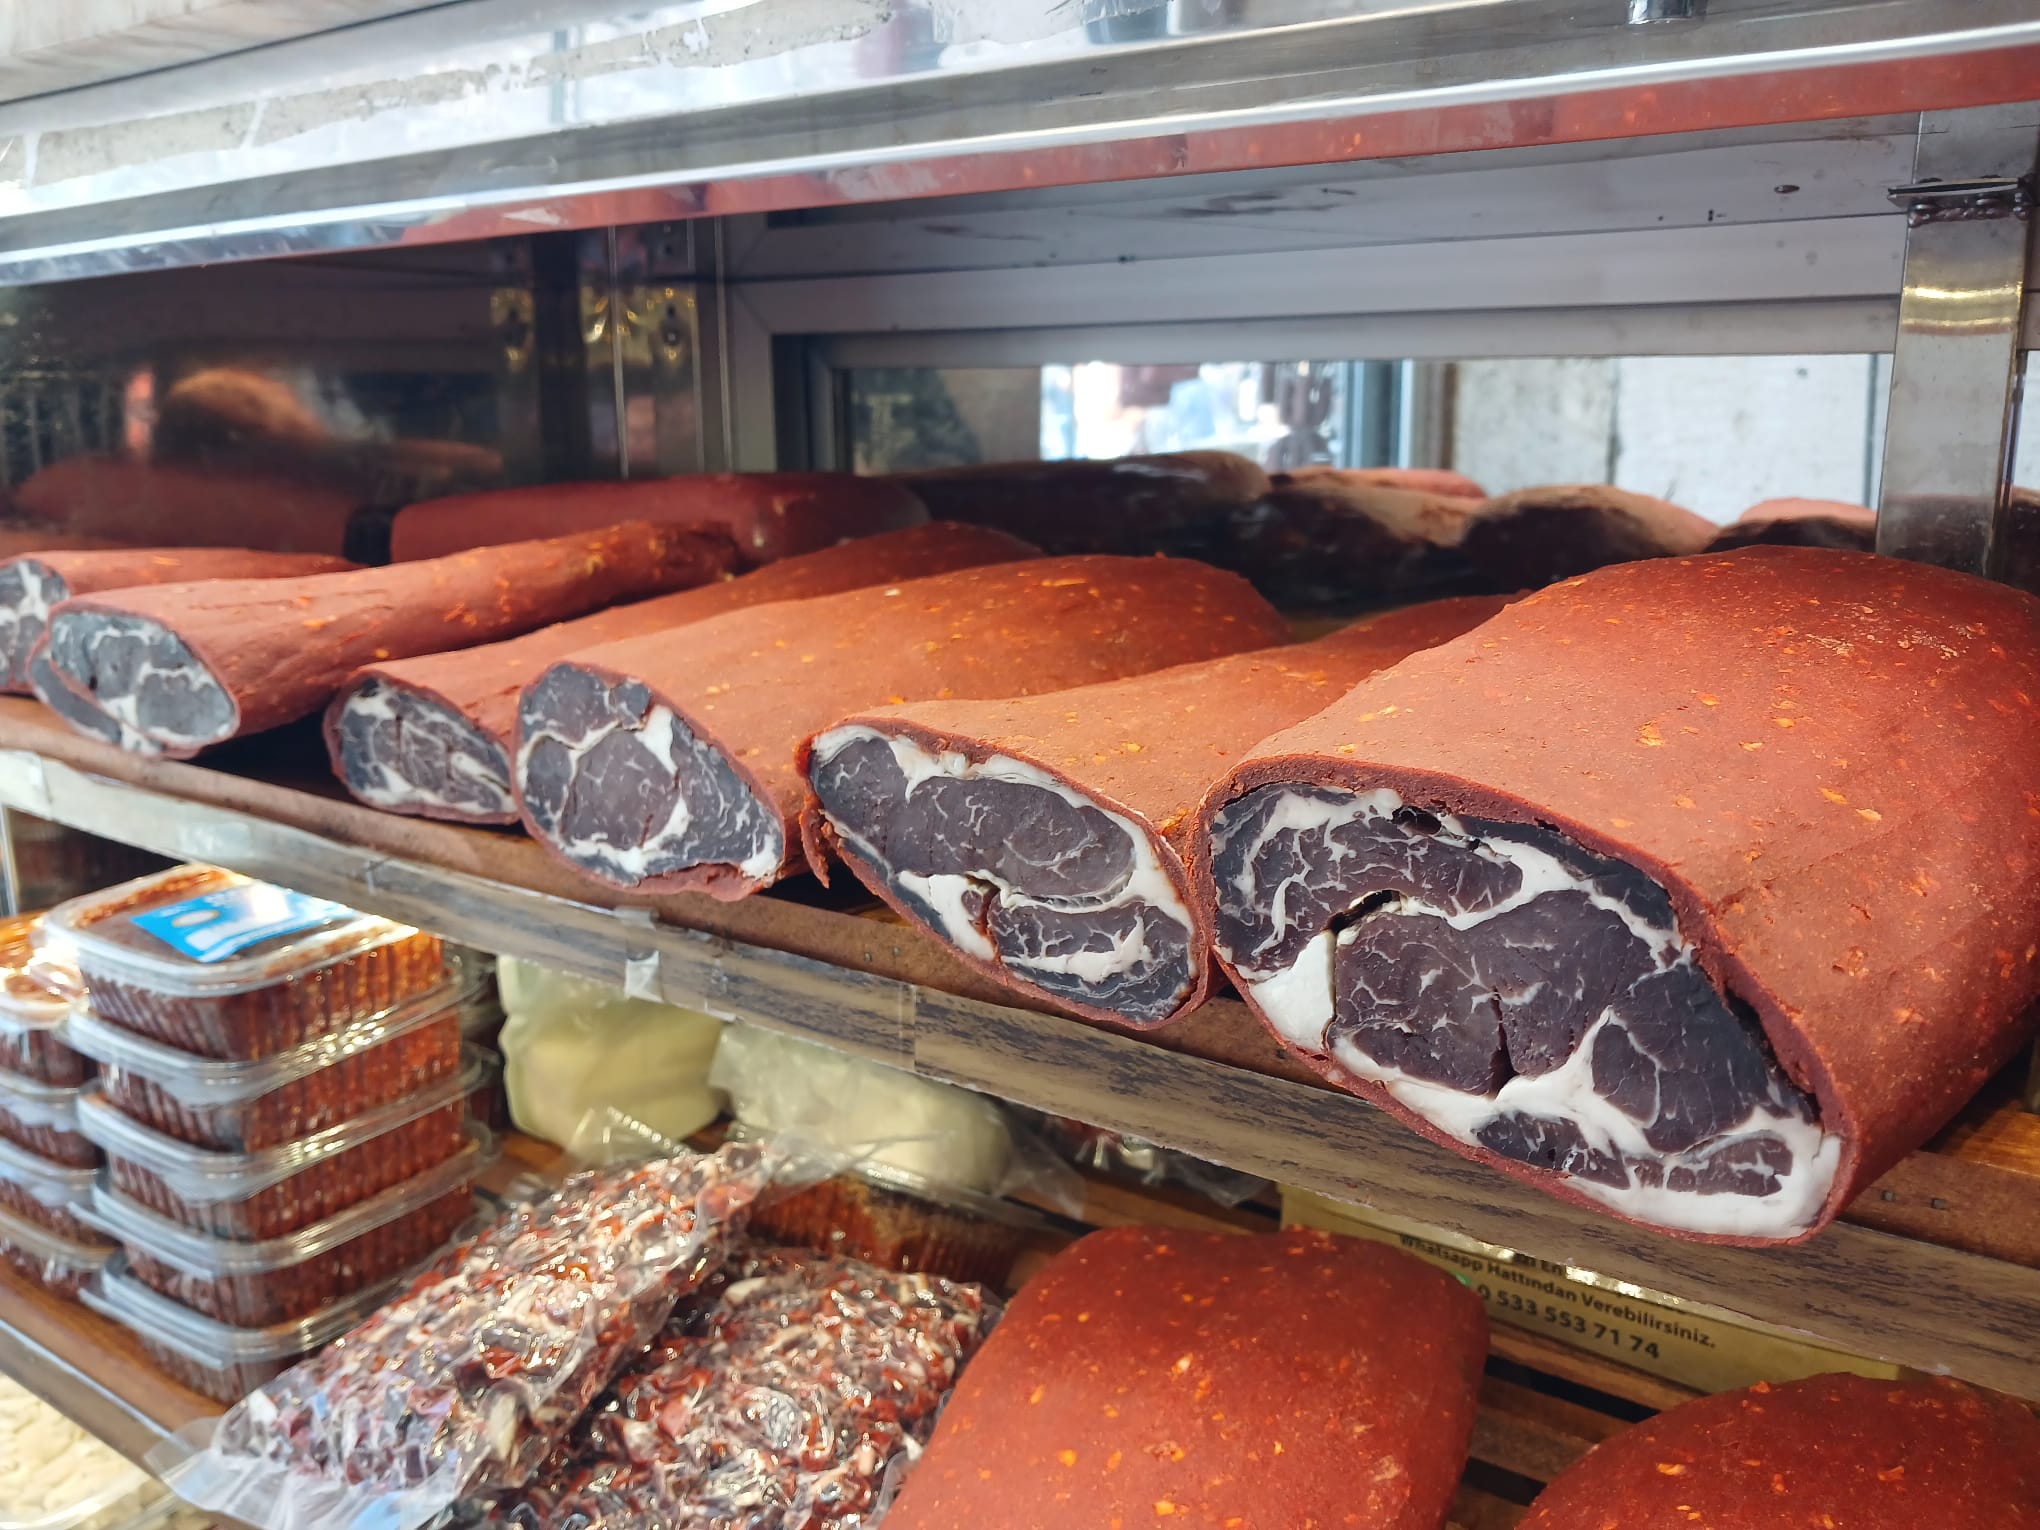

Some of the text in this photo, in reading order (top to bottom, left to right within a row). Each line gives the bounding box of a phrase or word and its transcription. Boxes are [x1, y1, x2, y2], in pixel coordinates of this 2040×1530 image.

[1401, 1234, 1483, 1272] Whatsapp
[1581, 1292, 1716, 1348] Verebilirsiniz.
[1497, 1290, 1537, 1316] 533
[1544, 1306, 1586, 1333] 553
[1593, 1322, 1620, 1345] 71
[1629, 1334, 1660, 1359] 74
